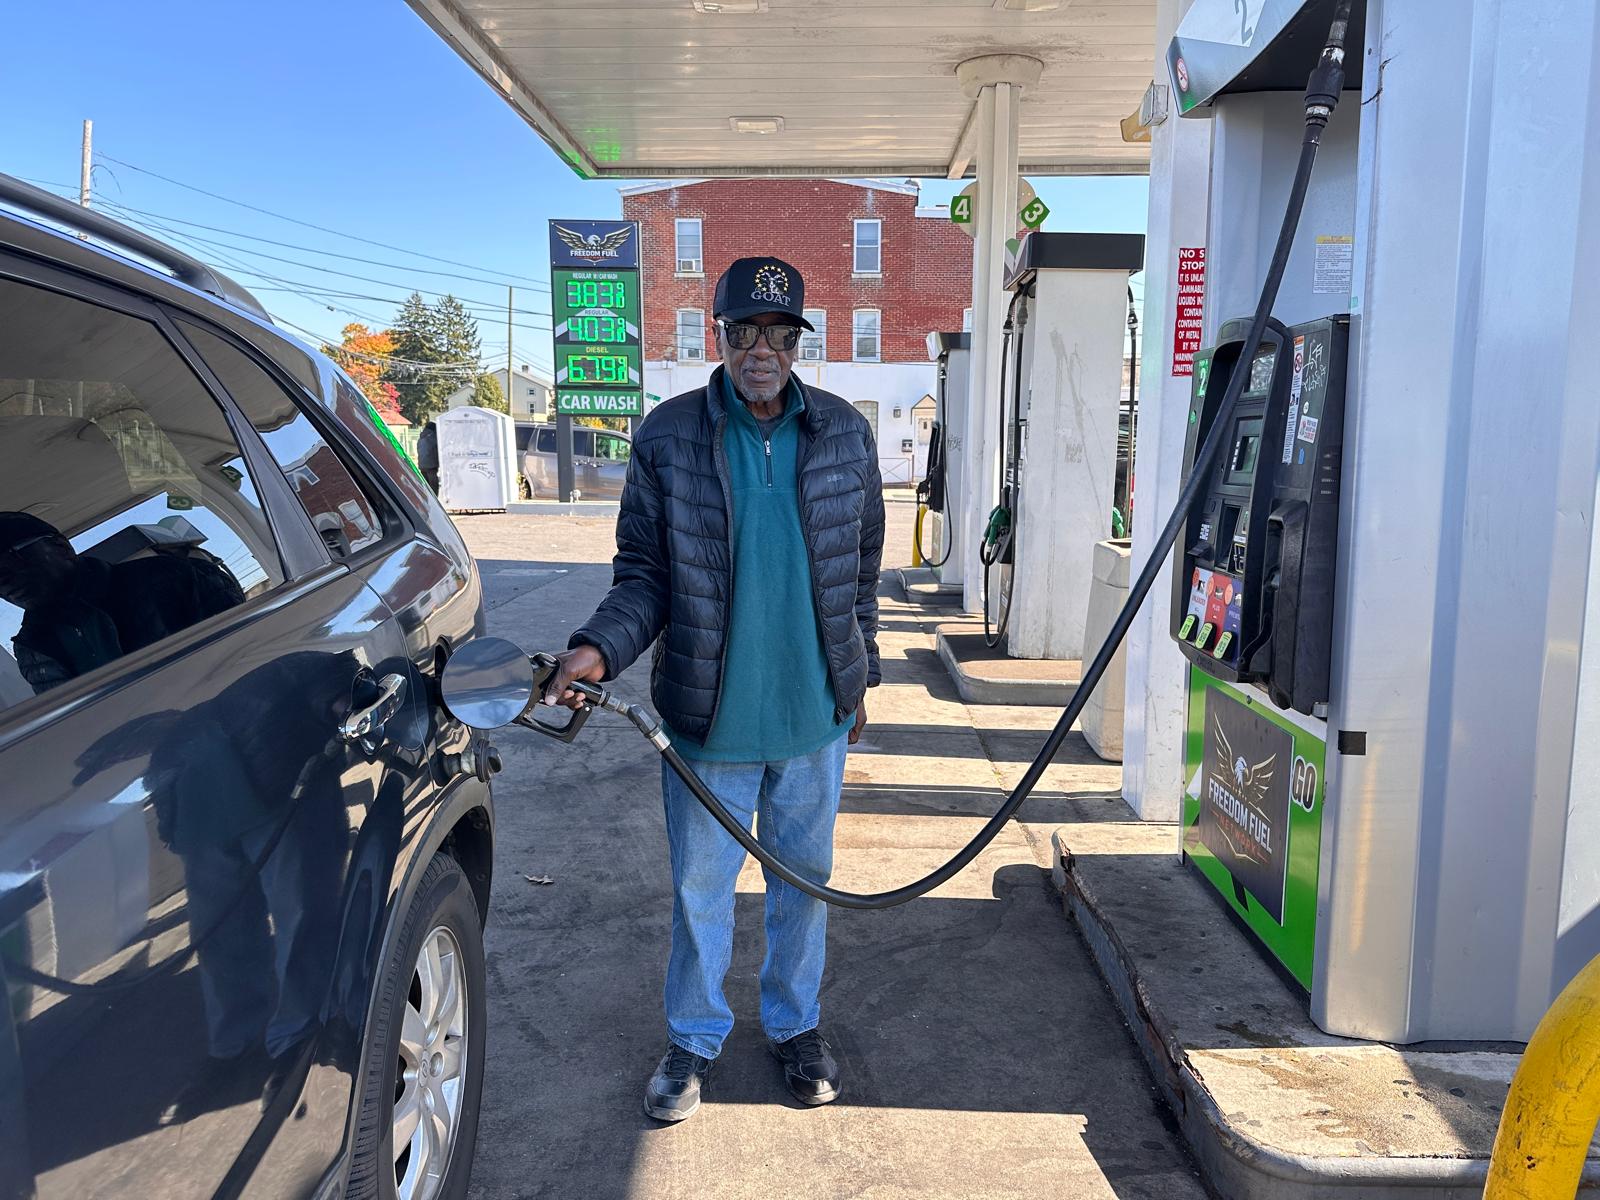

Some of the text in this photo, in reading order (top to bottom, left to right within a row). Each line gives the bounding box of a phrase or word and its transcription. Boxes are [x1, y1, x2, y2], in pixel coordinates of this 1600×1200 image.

[1235, 0, 1252, 44] 2
[954, 198, 969, 220] 4
[1024, 203, 1044, 222] 3
[570, 249, 619, 257] FREEDOM FUEL
[1180, 249, 1195, 258] NO
[1181, 261, 1205, 270] STOP
[567, 281, 614, 308] 3.83
[751, 290, 791, 307] GOAT
[567, 317, 615, 342] 4.03
[585, 346, 609, 354] DIESEL
[568, 356, 617, 381] 6.79
[561, 395, 591, 410] CAR
[593, 395, 637, 410] WASH
[1292, 755, 1317, 813] GO
[1208, 777, 1273, 854] FREEDOM FUEL
[1220, 814, 1257, 855] NETWORK
